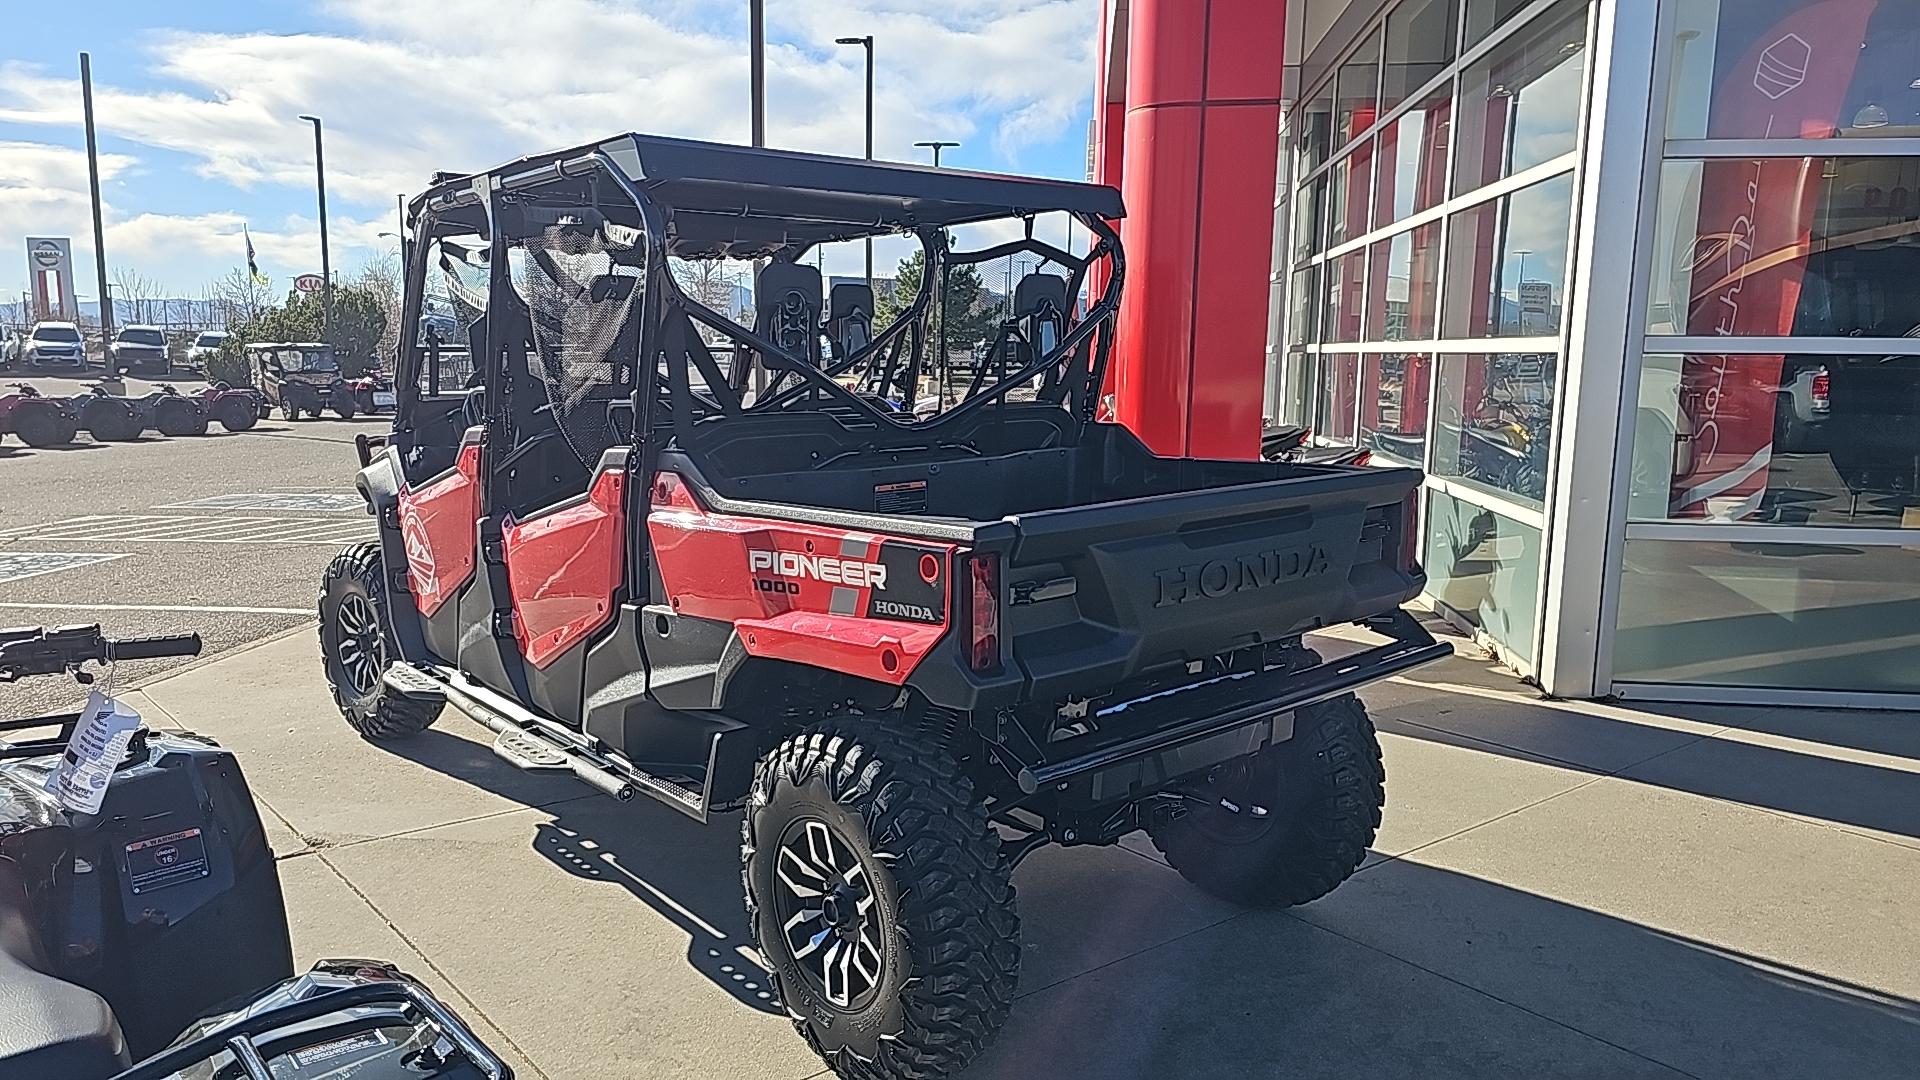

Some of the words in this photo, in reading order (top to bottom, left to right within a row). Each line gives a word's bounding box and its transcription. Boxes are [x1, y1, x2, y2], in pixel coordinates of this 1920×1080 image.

[300, 279, 321, 289] KIA
[749, 549, 887, 590] PIONEER
[1154, 543, 1330, 609] HONDA
[752, 577, 800, 595] 1000
[874, 600, 936, 621] HONDA
[146, 832, 186, 847] WARNING
[162, 855, 173, 864] 16
